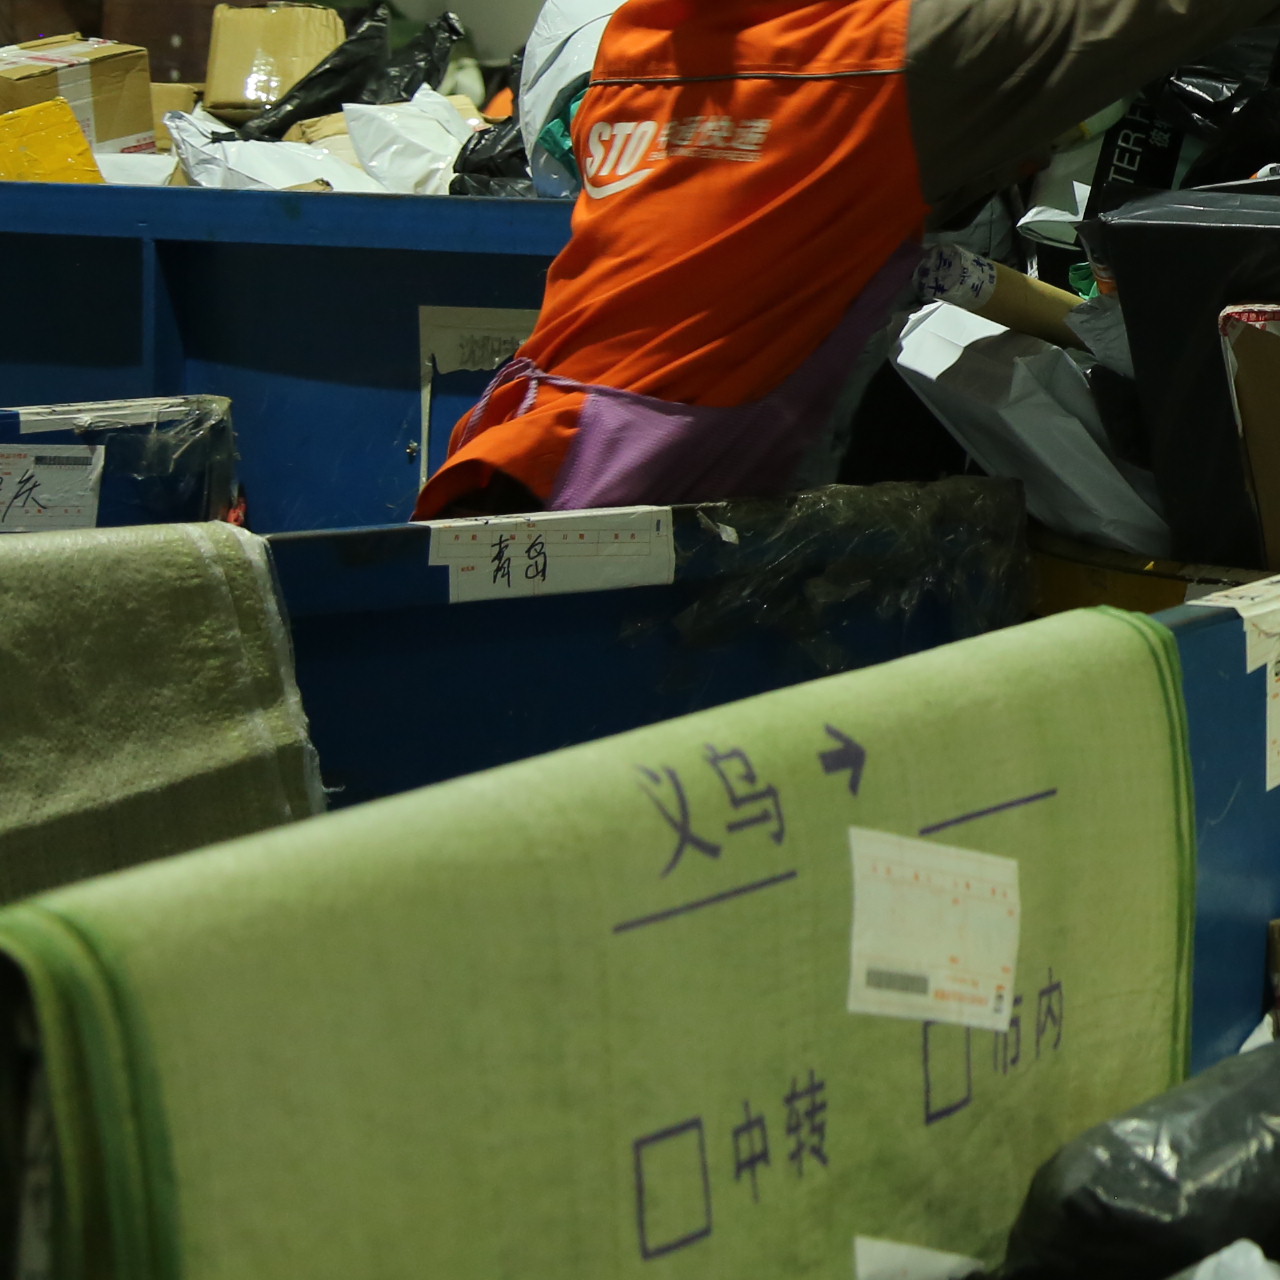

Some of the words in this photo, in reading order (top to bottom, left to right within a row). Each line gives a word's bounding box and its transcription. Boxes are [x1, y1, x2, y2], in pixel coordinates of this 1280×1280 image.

[585, 120, 659, 179] STO
[491, 533, 548, 588] 青岛
[634, 742, 787, 880] 义乌
[731, 1068, 831, 1204] 中转
